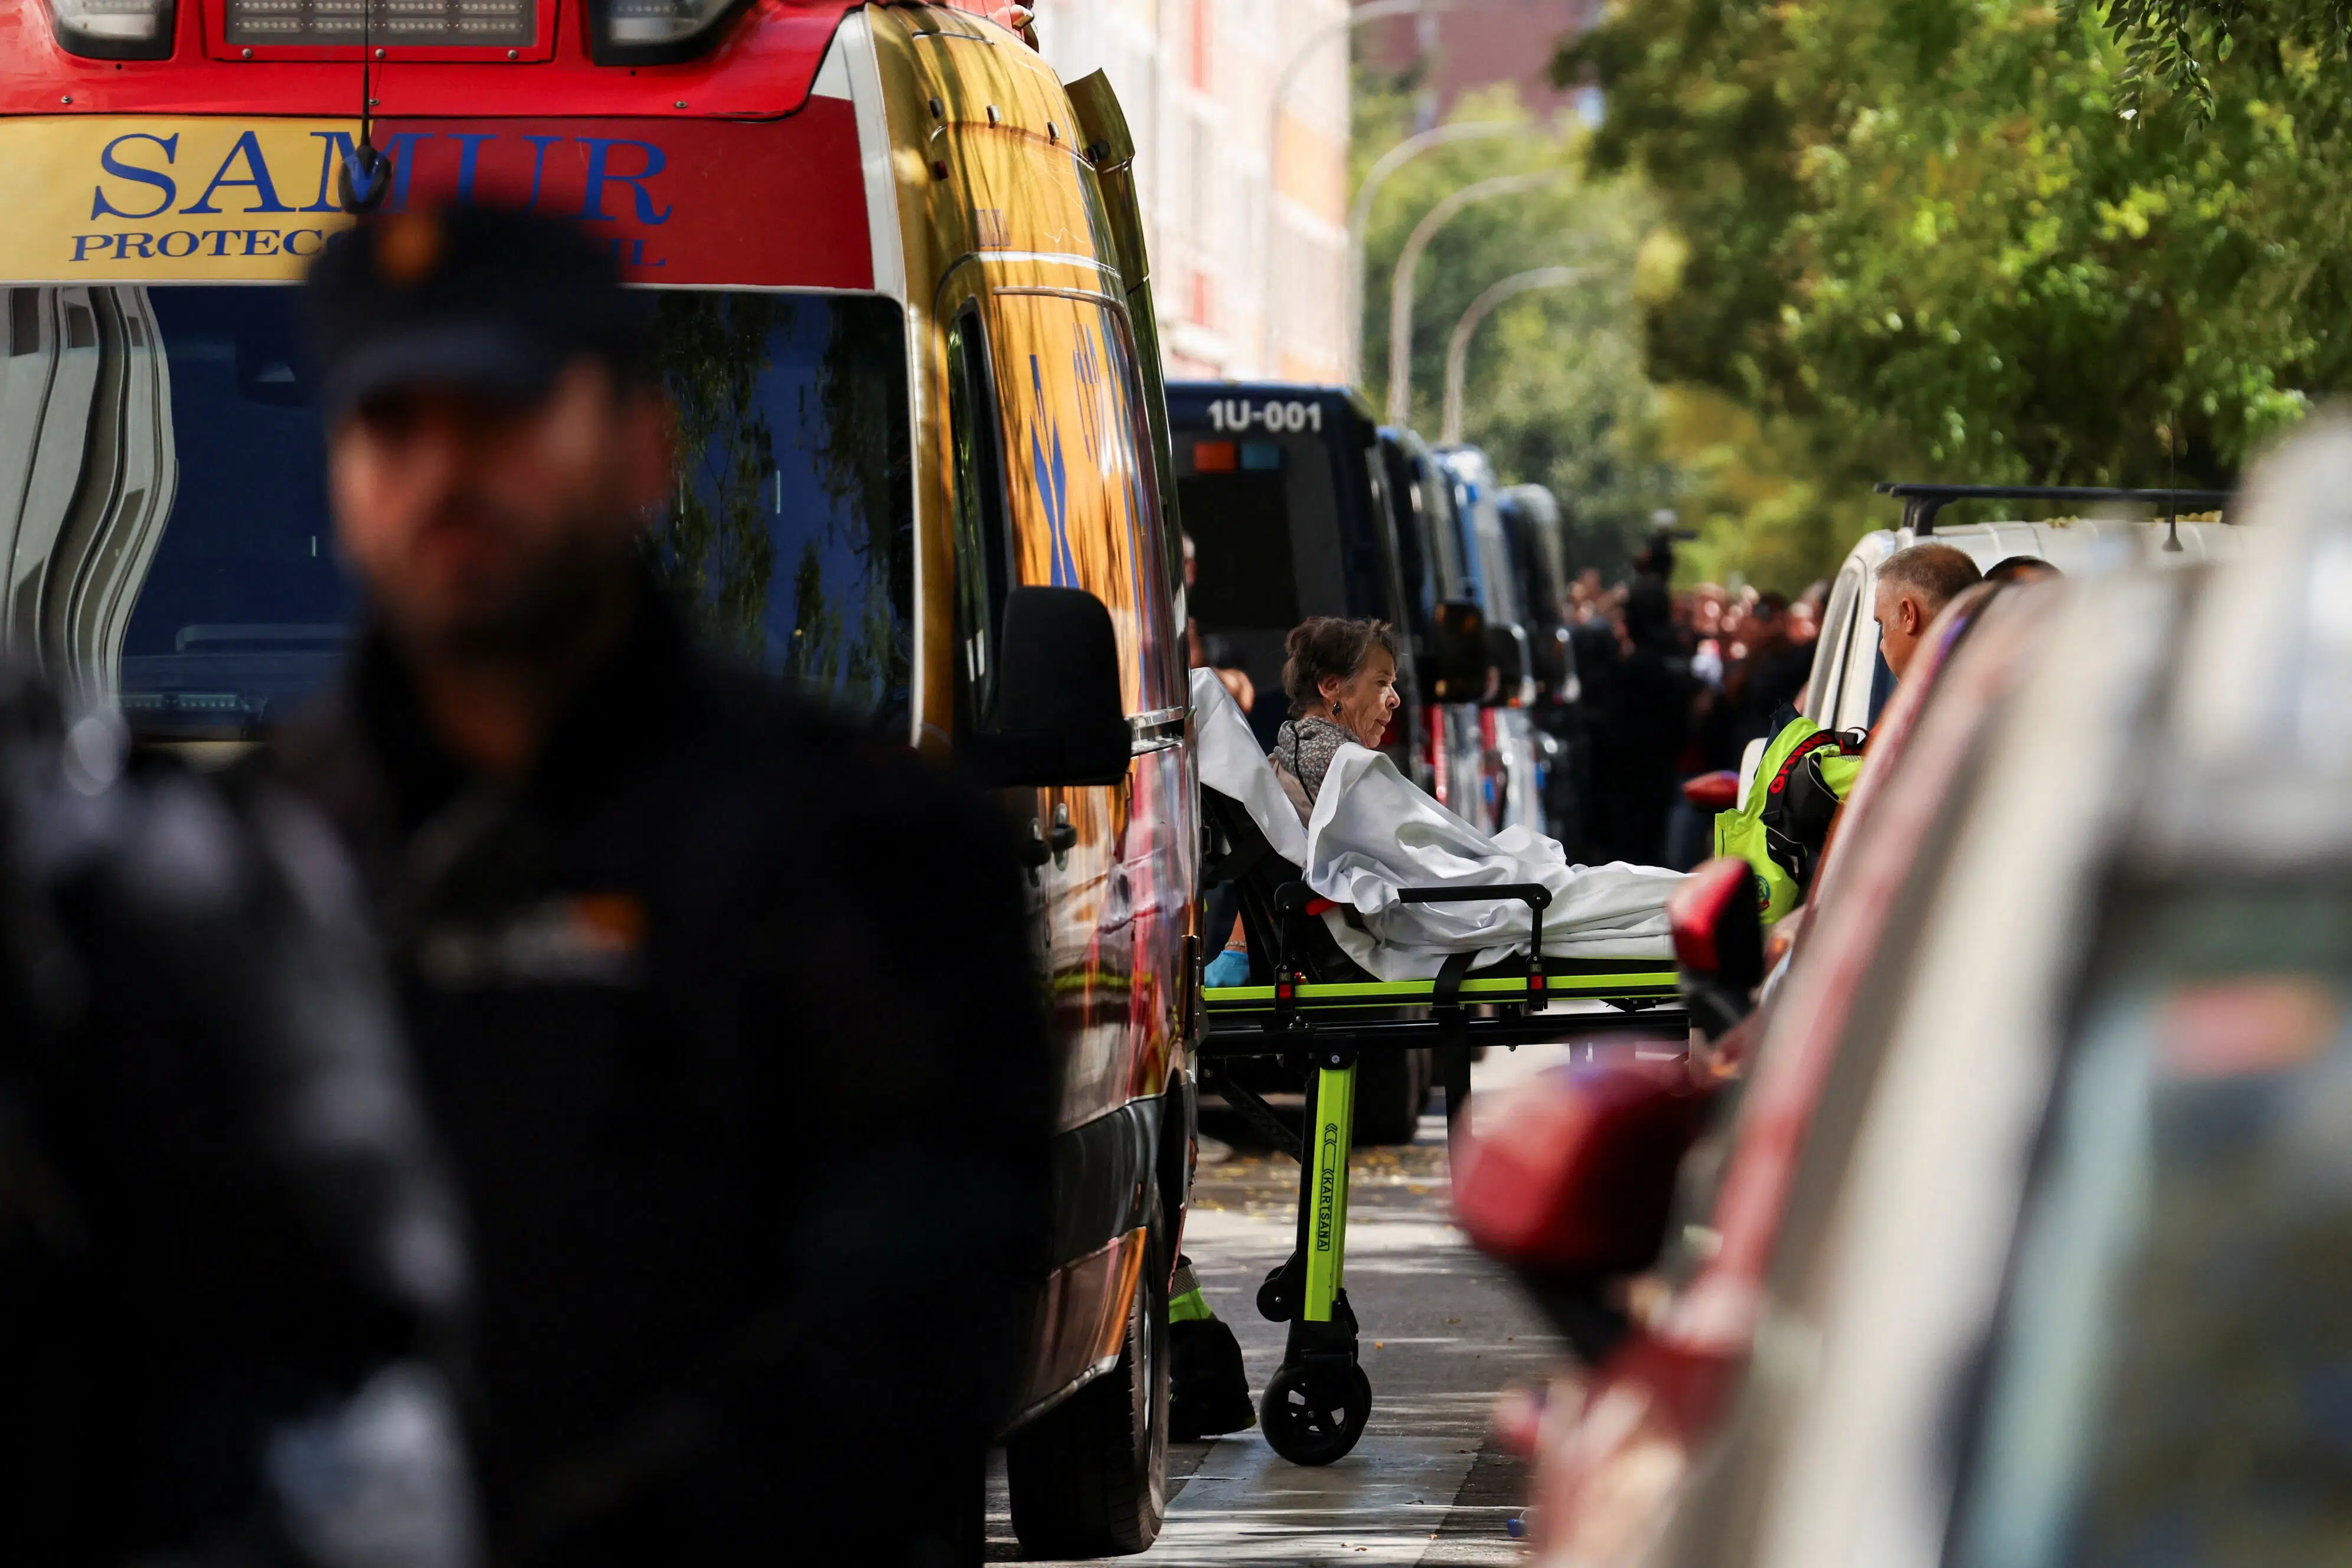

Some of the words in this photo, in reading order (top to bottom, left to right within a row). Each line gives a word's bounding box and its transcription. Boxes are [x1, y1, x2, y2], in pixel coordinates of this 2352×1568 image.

[91, 130, 672, 226] SAMUR
[70, 229, 329, 262] PROTEC
[1208, 400, 1321, 432] 1U-001
[1319, 1177, 1332, 1247] KARTSANA
